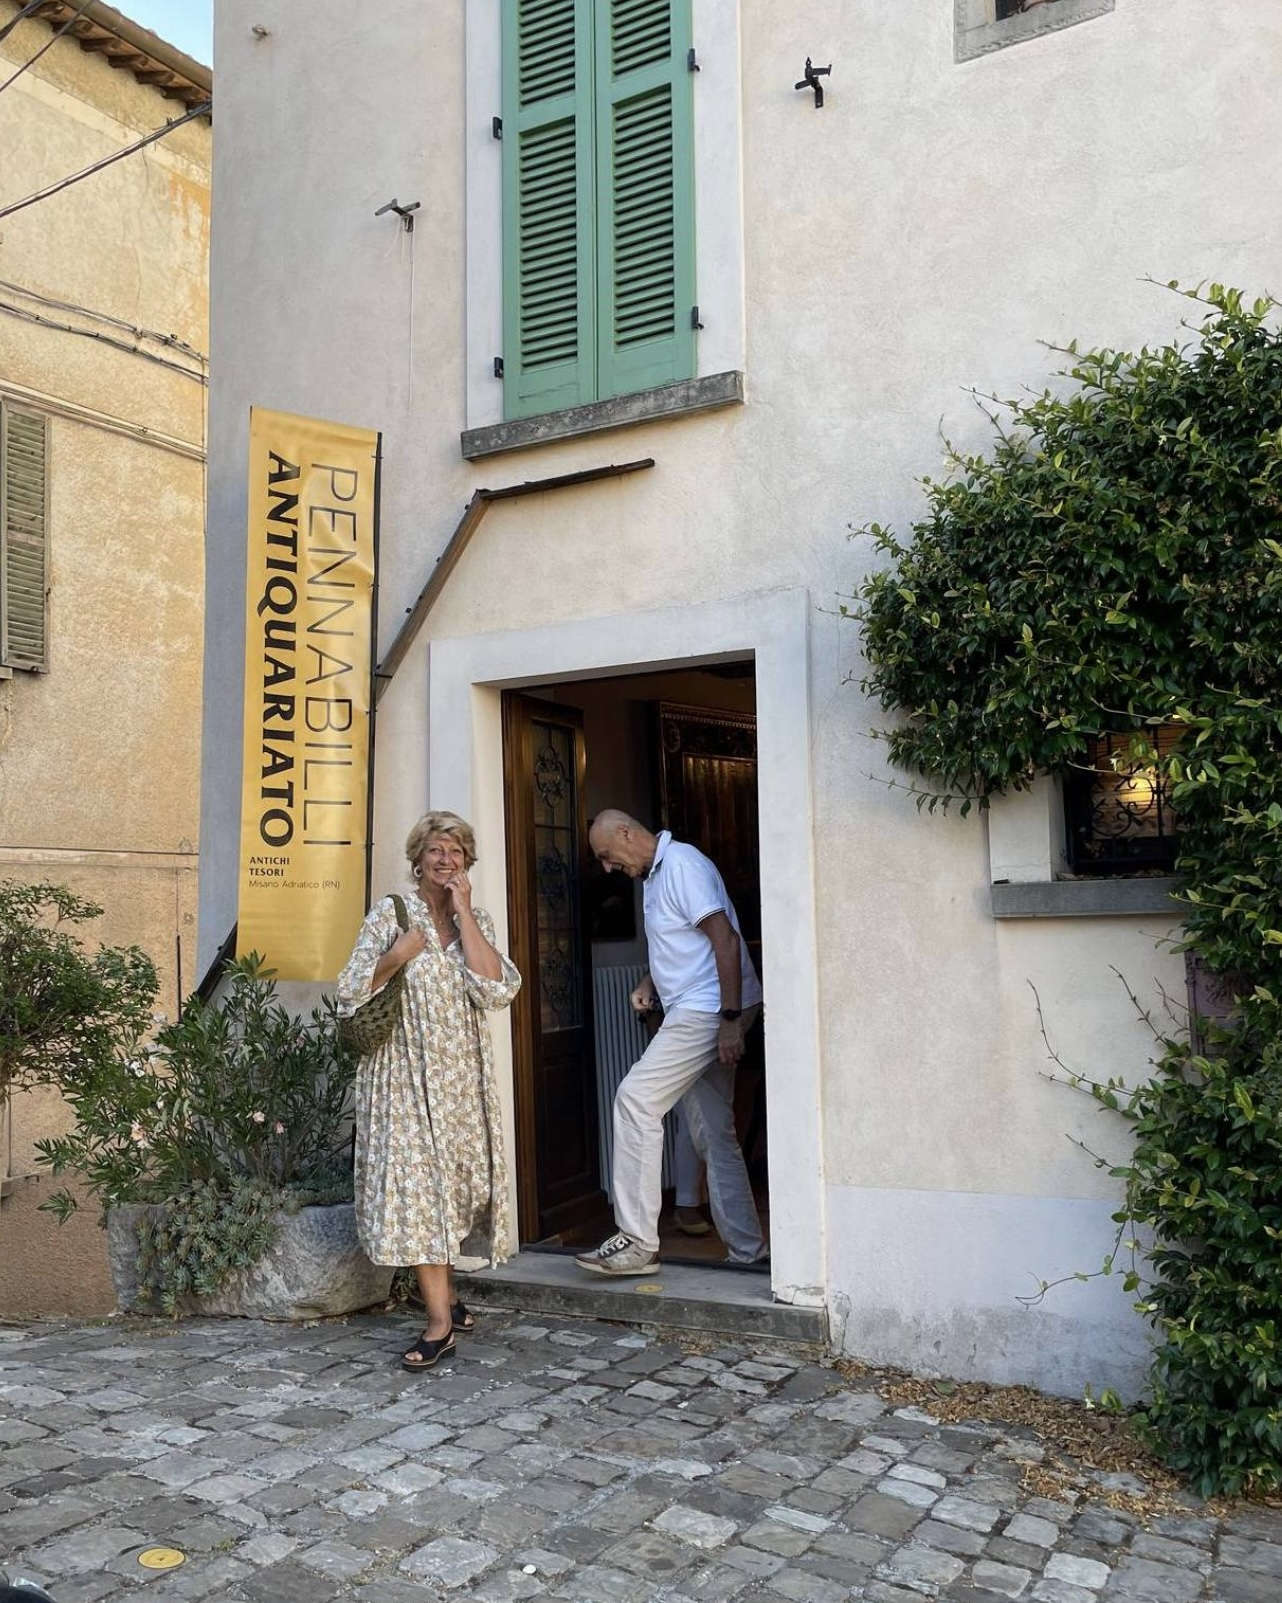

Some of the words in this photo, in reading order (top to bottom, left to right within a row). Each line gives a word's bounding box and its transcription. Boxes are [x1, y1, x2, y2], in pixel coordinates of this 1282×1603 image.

[257, 450, 300, 847] ANTIQUARIATO
[303, 463, 358, 845] PENNABILLI
[249, 856, 290, 865] ANTICHI
[249, 868, 284, 877] TESORI
[248, 880, 279, 889] Misano
[281, 880, 320, 889] Adriatico
[322, 880, 341, 890] (RN)
